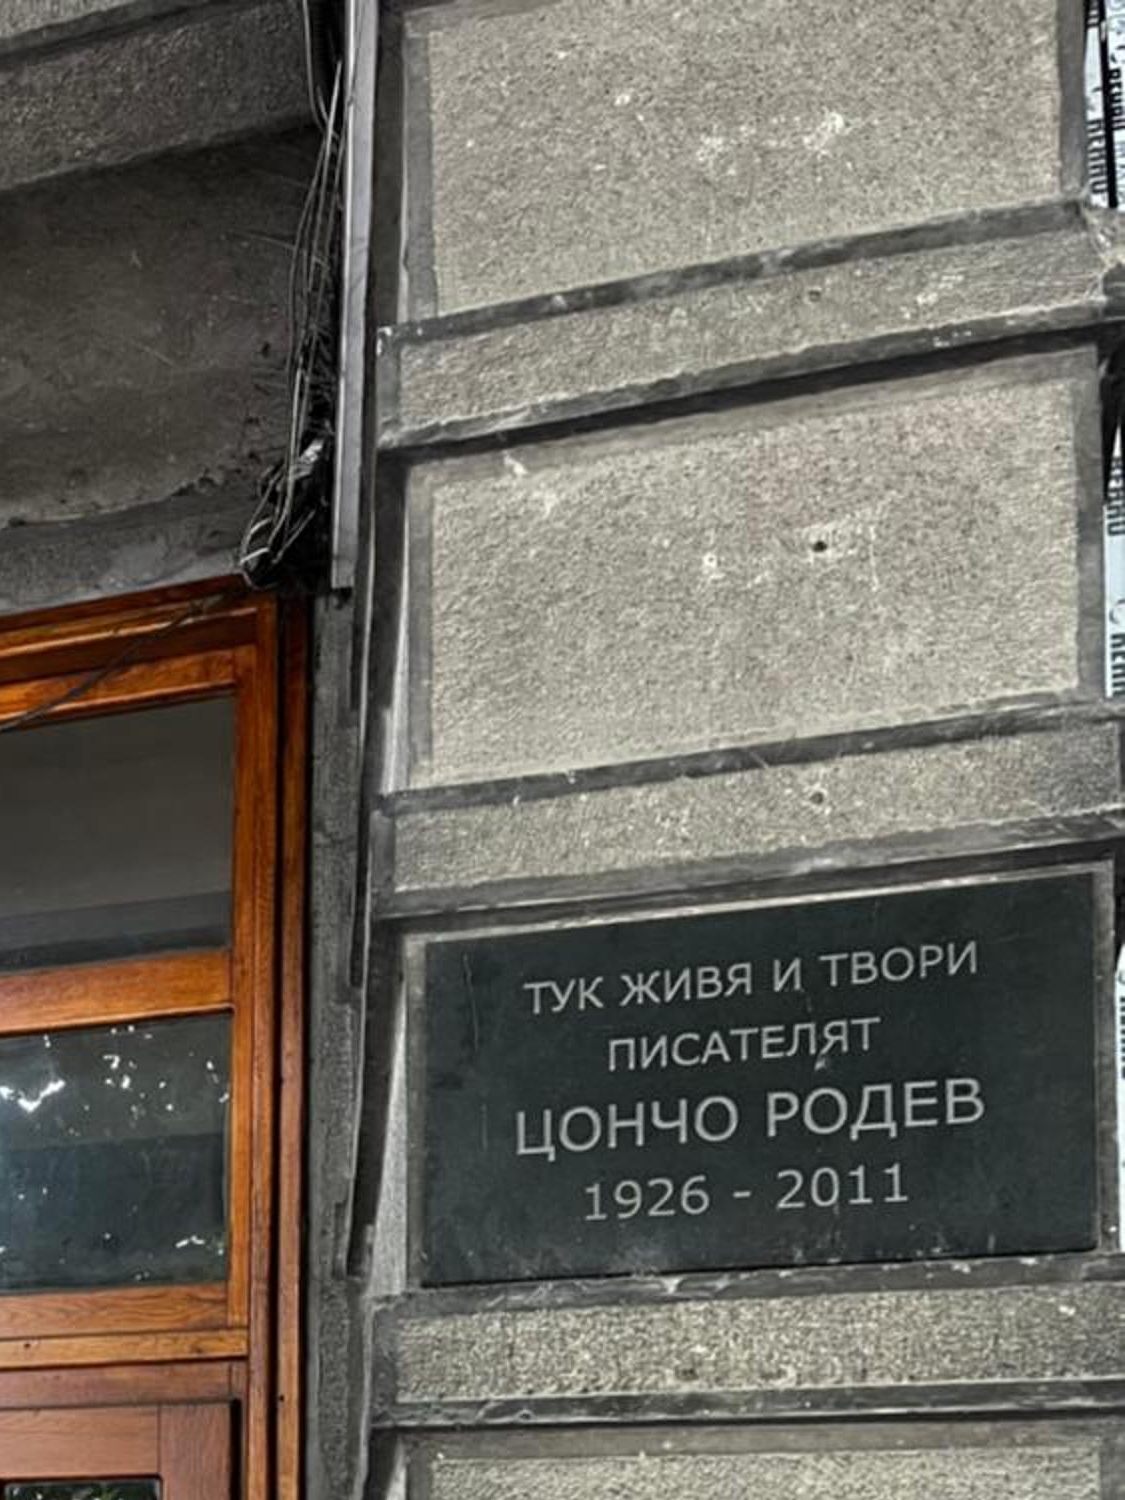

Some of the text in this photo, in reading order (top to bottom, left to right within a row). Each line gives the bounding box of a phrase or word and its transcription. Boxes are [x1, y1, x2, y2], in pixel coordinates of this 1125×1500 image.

[521, 941, 977, 1015] ТУК ЖИВЯ И ТВОРИ
[608, 1016, 881, 1072] ПИСАТЕЛЯТ
[515, 1078, 985, 1163] ЦОНЧО РОДЕВ
[584, 1175, 710, 1221] 1926
[776, 1163, 909, 1210] 2011
